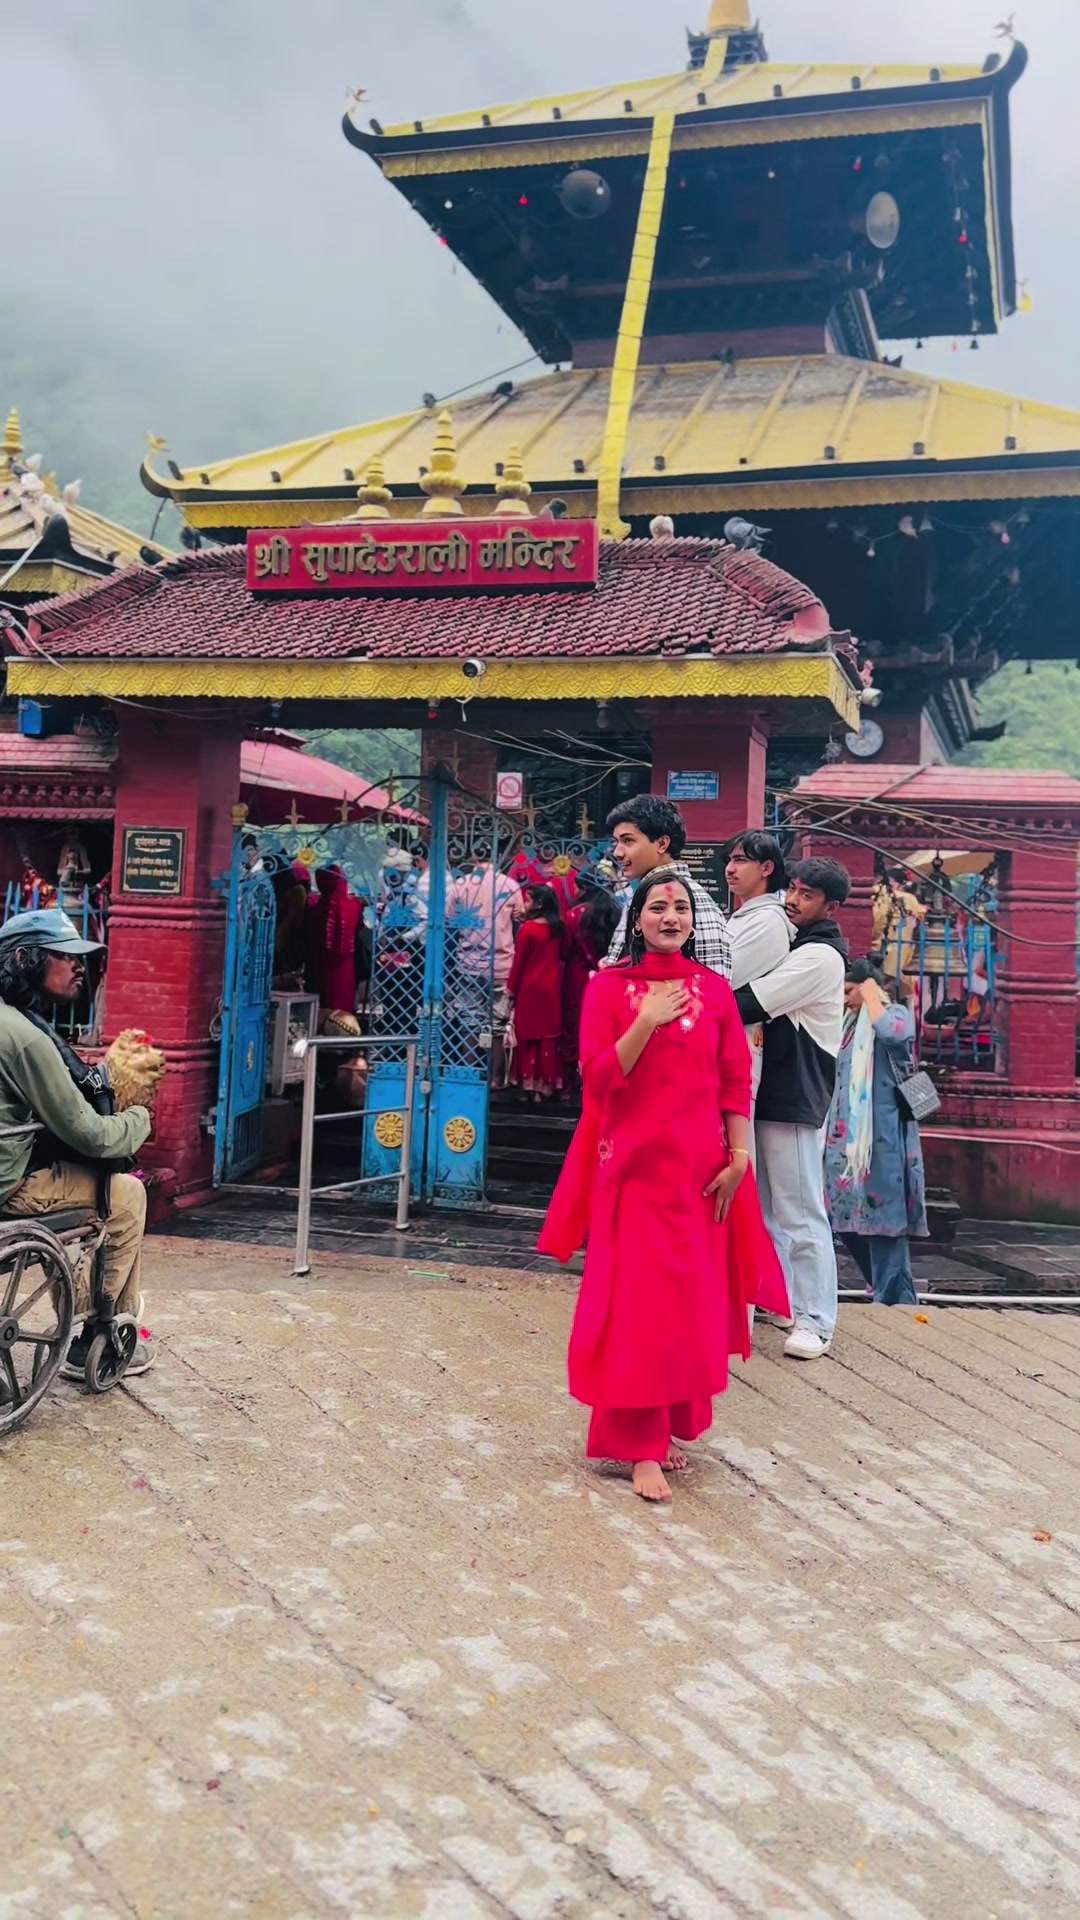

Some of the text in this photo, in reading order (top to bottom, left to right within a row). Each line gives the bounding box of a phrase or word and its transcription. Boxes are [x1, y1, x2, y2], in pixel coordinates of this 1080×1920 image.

[255, 527, 580, 582] श्री सुपादेउराली मन्दिर
